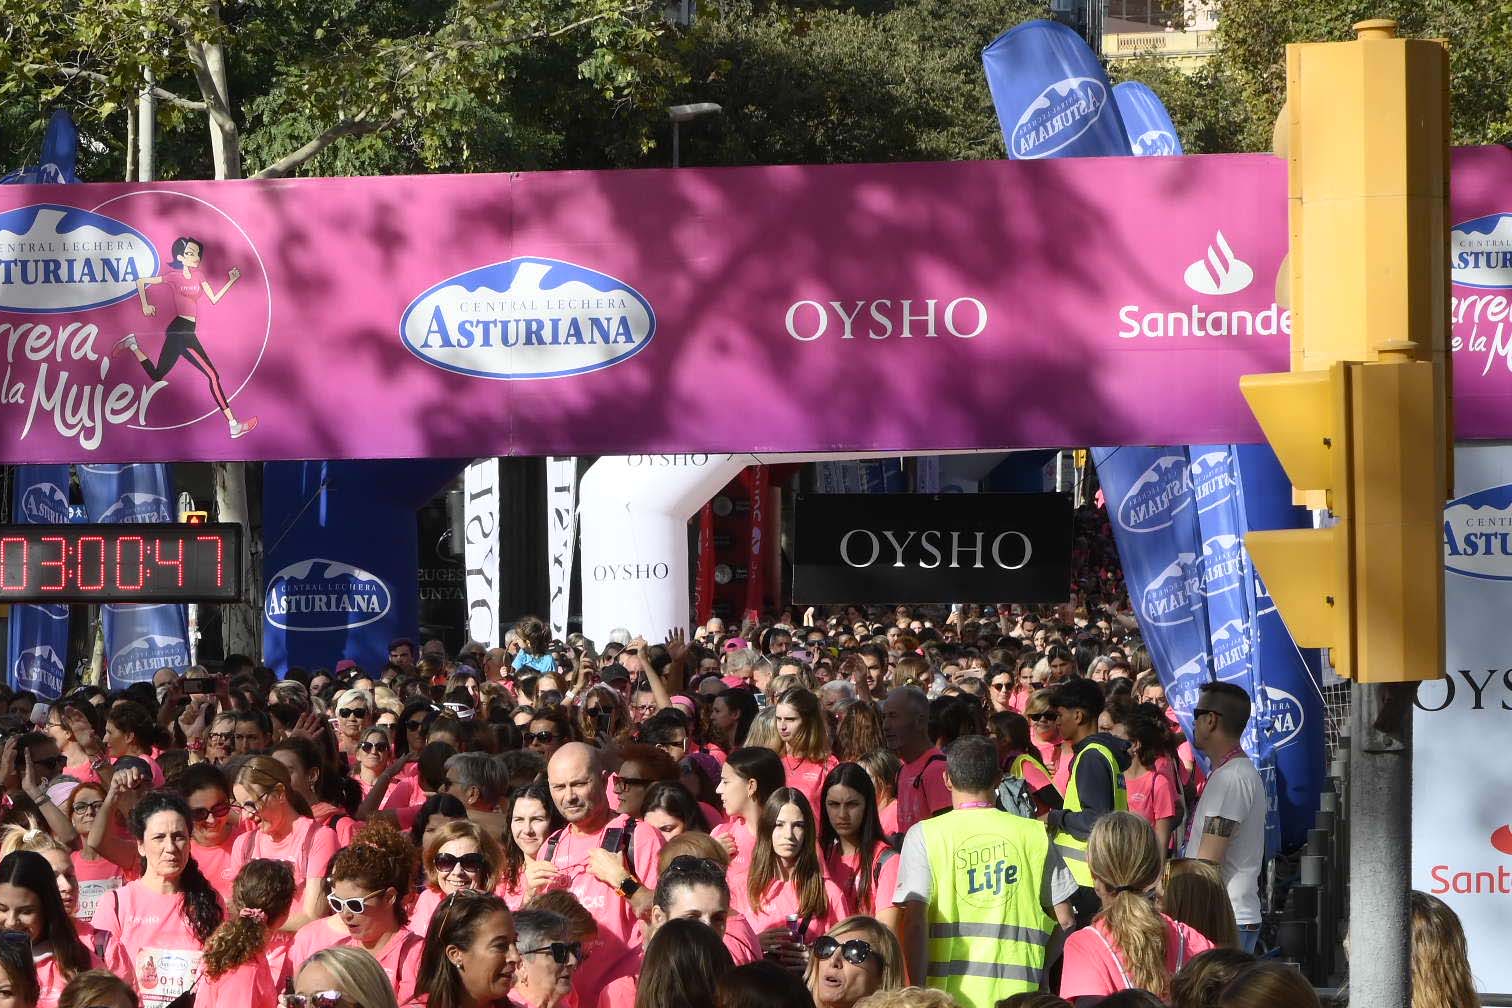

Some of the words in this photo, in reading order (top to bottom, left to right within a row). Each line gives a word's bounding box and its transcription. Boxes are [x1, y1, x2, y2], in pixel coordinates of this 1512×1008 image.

[63, 240, 135, 253] LECHERA
[459, 300, 539, 312] CENTRAL
[548, 298, 627, 310] LECHERA
[785, 296, 988, 342] OYSHO
[1119, 304, 1292, 339] Santande
[420, 304, 636, 349] ASTURIANA
[1, 365, 25, 404] la
[20, 358, 169, 451] Mujer
[0, 536, 222, 590] 03:00:47
[840, 529, 1033, 569] OYSHO
[593, 562, 669, 582] OYSHO
[269, 587, 381, 615] ASTURIANA
[956, 841, 1009, 870] Sport
[967, 860, 1018, 895] Life
[1431, 865, 1512, 894] Sant
